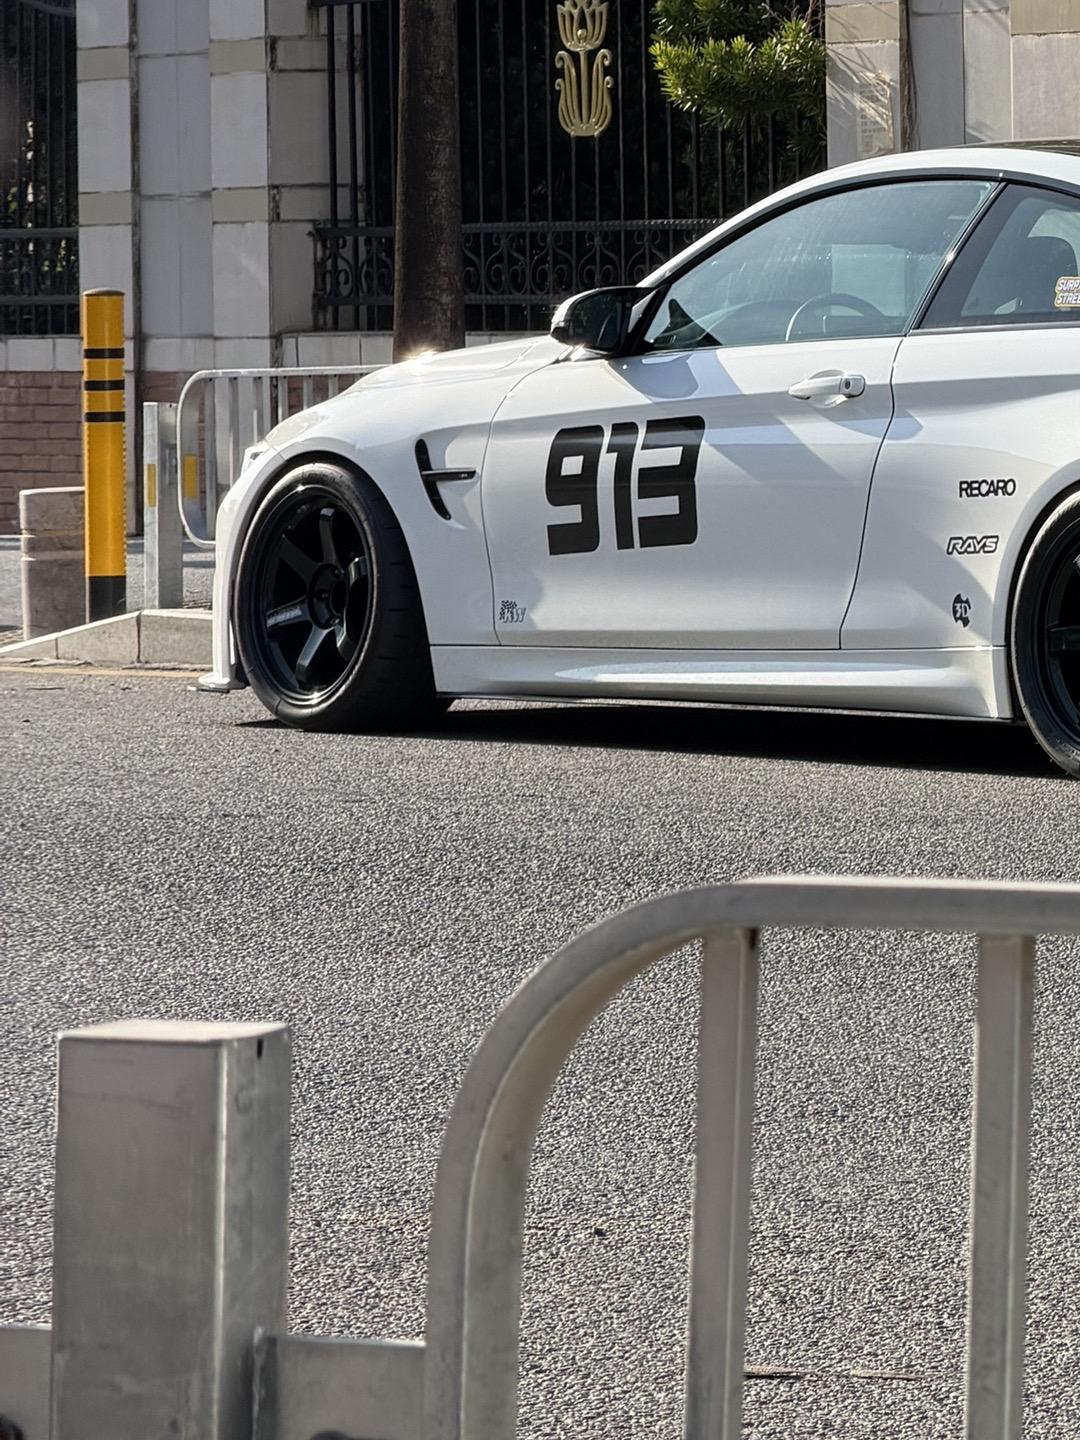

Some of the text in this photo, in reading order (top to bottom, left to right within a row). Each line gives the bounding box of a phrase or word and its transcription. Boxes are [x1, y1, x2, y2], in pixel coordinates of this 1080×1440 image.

[545, 415, 705, 556] 913
[959, 478, 1016, 498] RECARO
[947, 535, 999, 555] RAYS
